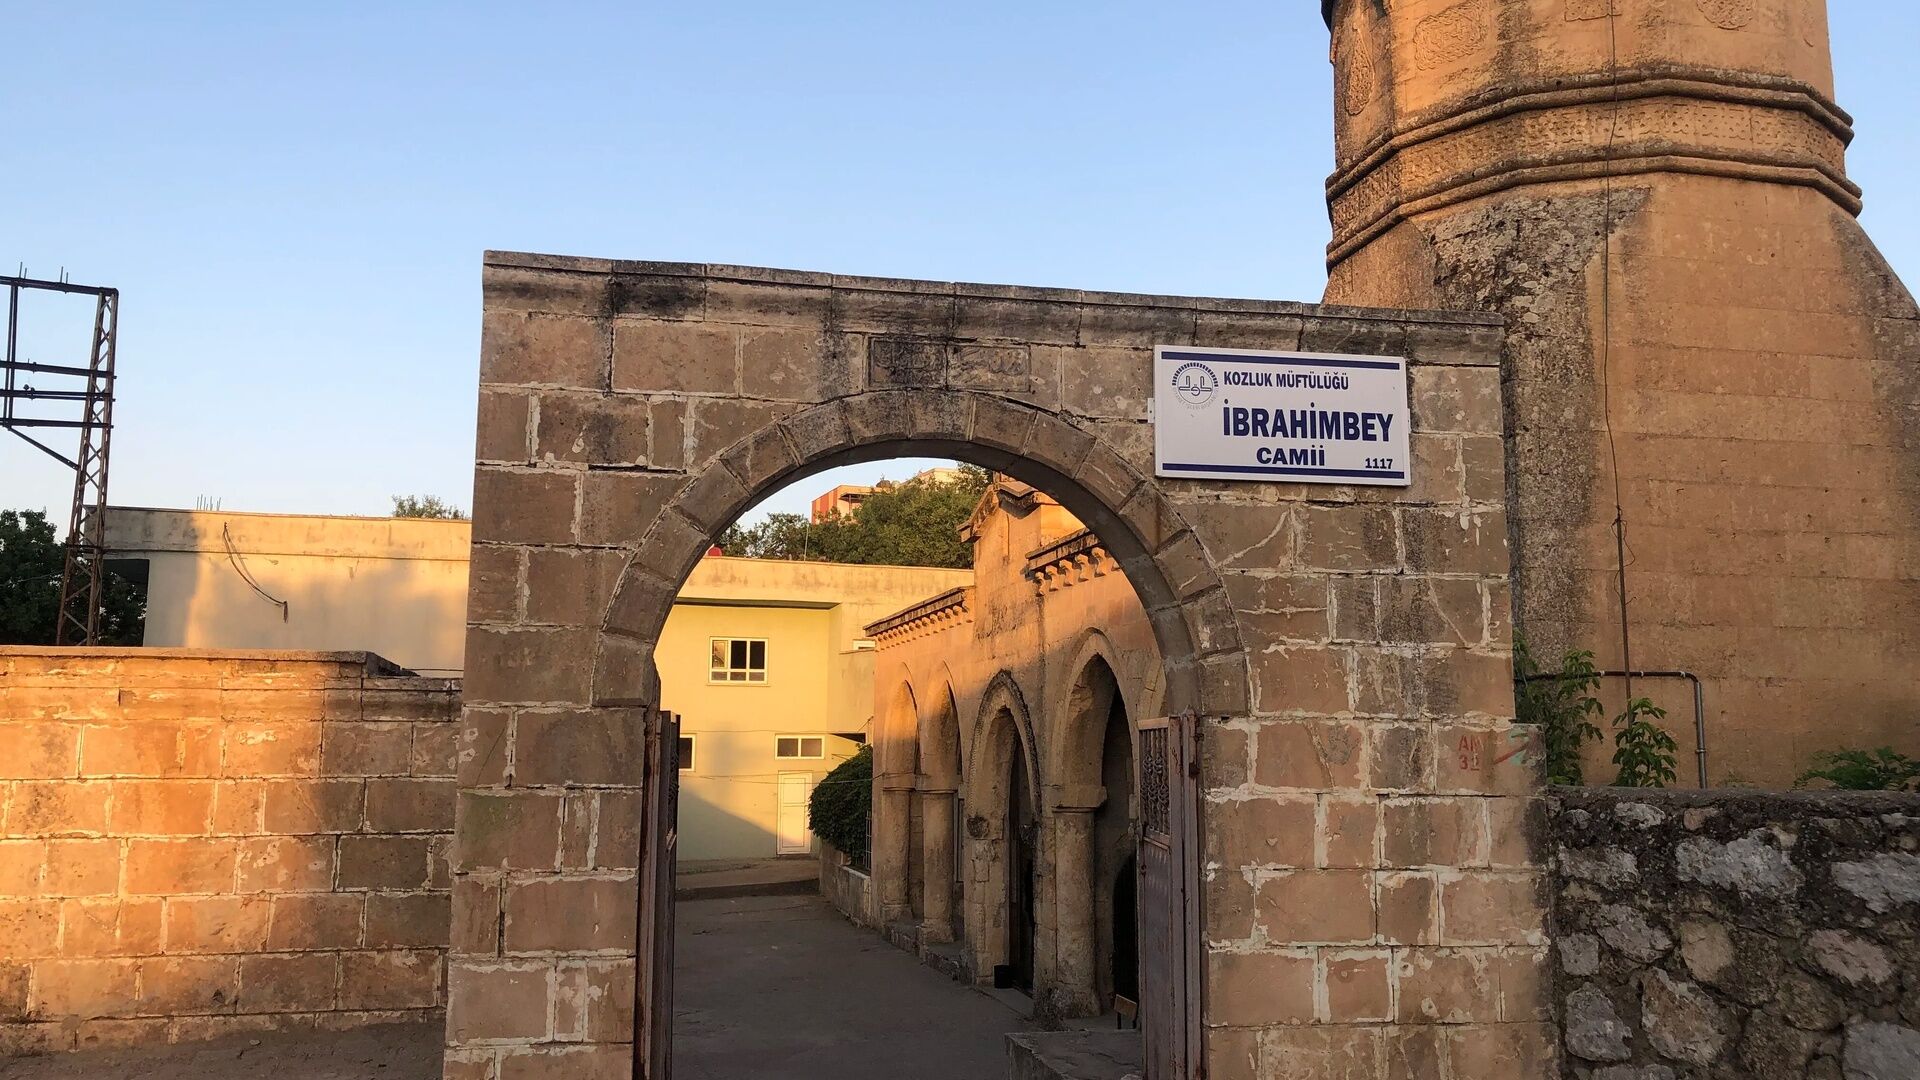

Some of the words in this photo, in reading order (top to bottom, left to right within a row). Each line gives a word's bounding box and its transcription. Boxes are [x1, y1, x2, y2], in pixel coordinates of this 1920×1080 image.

[1223, 371, 1272, 387] KOZLUK
[1276, 370, 1349, 390] MÜFTÜLÜĞÜ
[1223, 398, 1394, 442] İBRAHİMBEY
[1364, 457, 1393, 470] 1117
